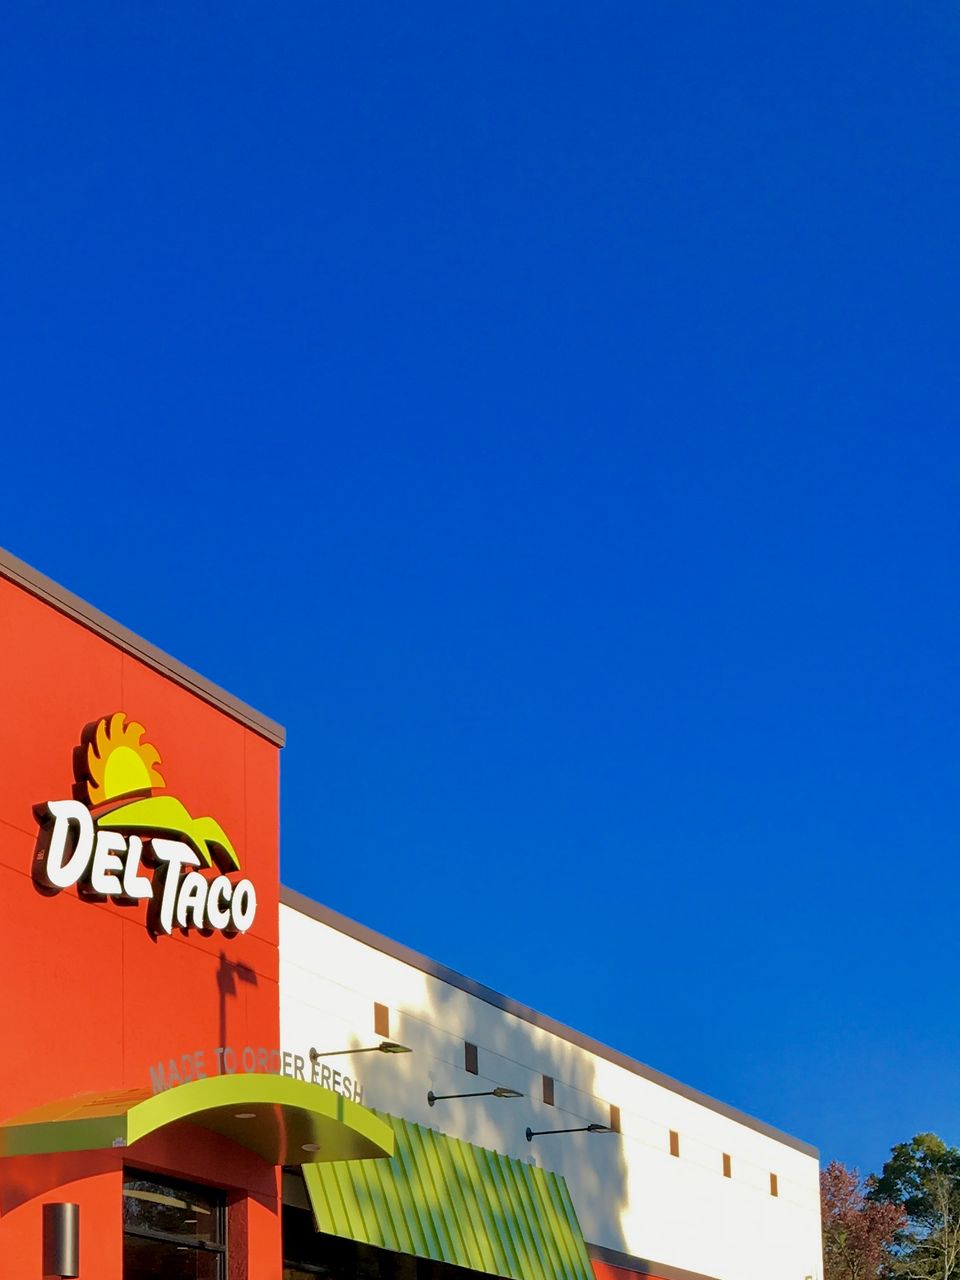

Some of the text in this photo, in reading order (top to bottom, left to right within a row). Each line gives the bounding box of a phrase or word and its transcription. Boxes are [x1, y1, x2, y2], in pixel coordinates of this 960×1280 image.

[46, 799, 257, 935] DEL TACO
[148, 1047, 364, 1104] MADE TO ORDER FRESH
